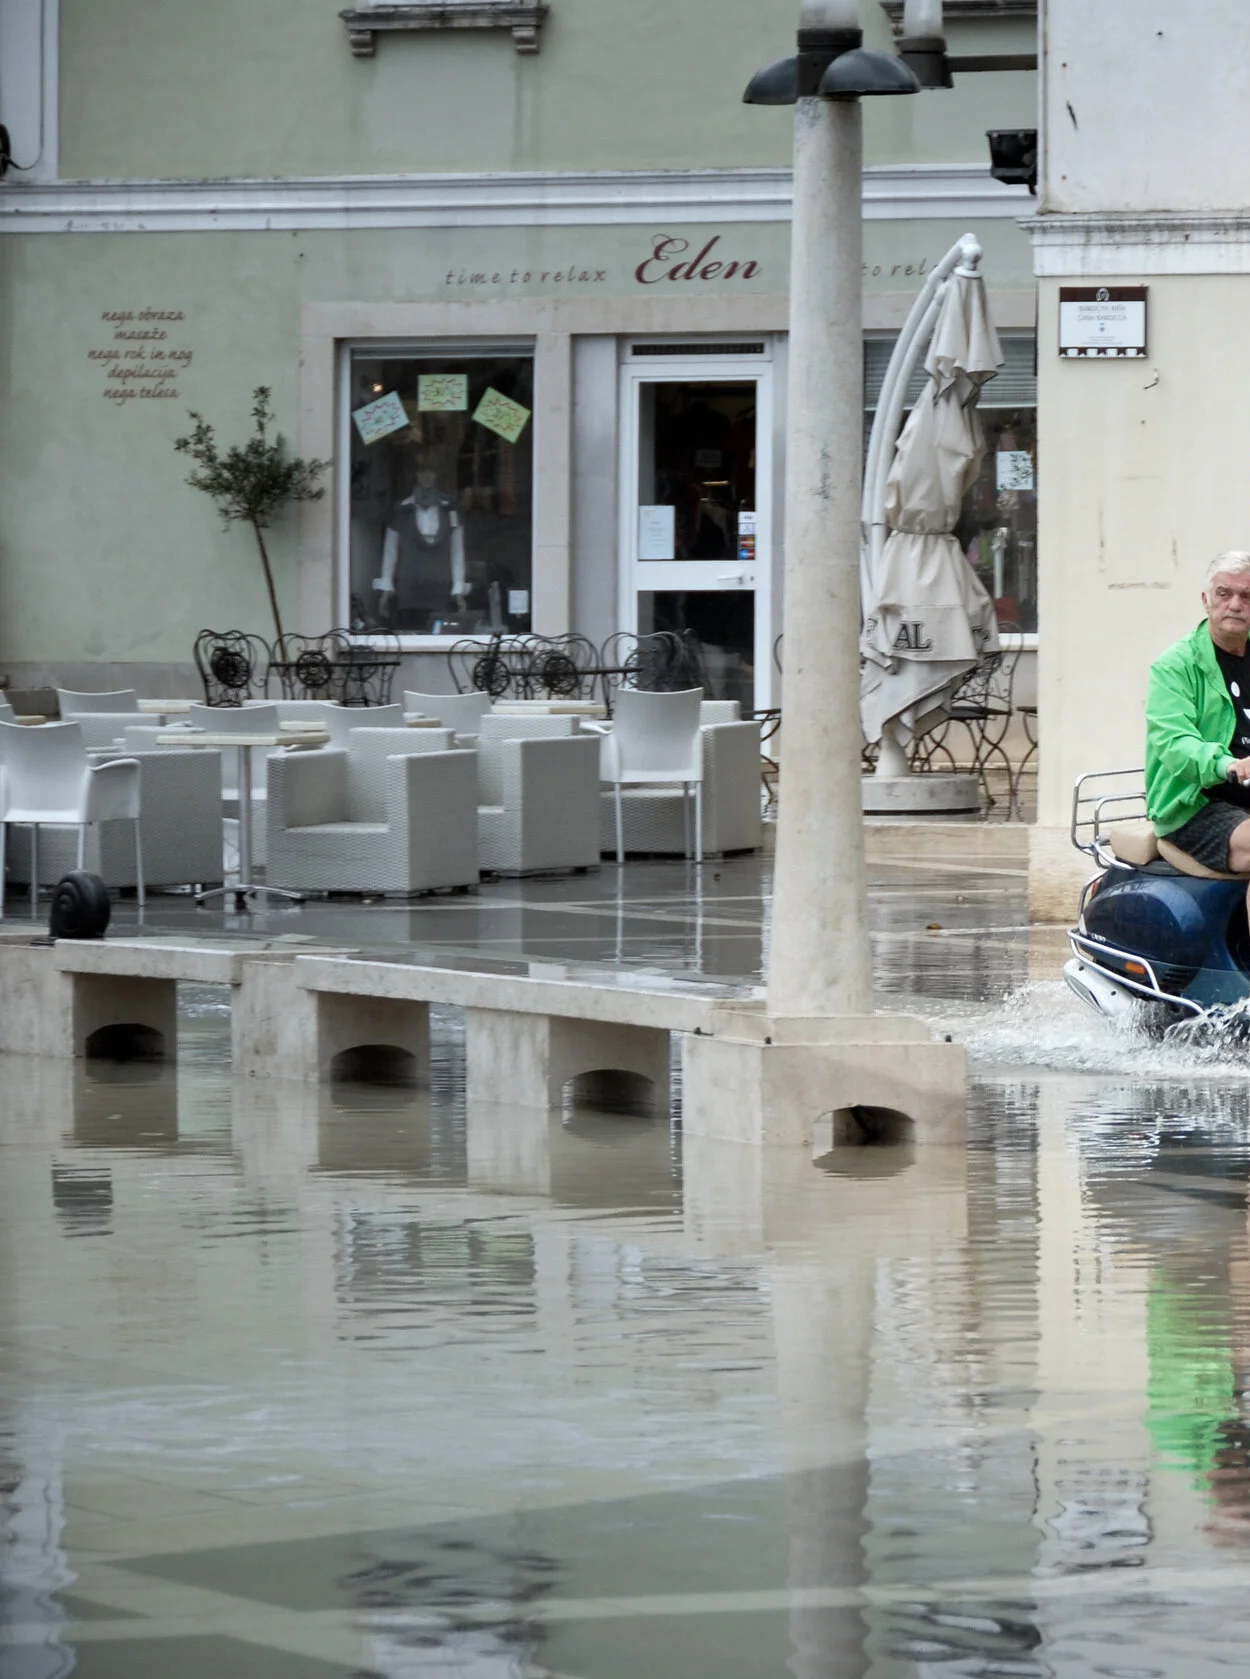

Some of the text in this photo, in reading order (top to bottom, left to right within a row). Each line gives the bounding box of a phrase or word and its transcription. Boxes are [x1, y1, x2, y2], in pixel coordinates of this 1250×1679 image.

[635, 233, 761, 284] Eden
[445, 264, 606, 285] time to relax
[101, 305, 185, 329] nega obraza
[114, 327, 167, 340] masaže
[87, 345, 193, 368] nega rok in nog
[107, 363, 178, 391] depilacija
[102, 387, 180, 406] nega telesa
